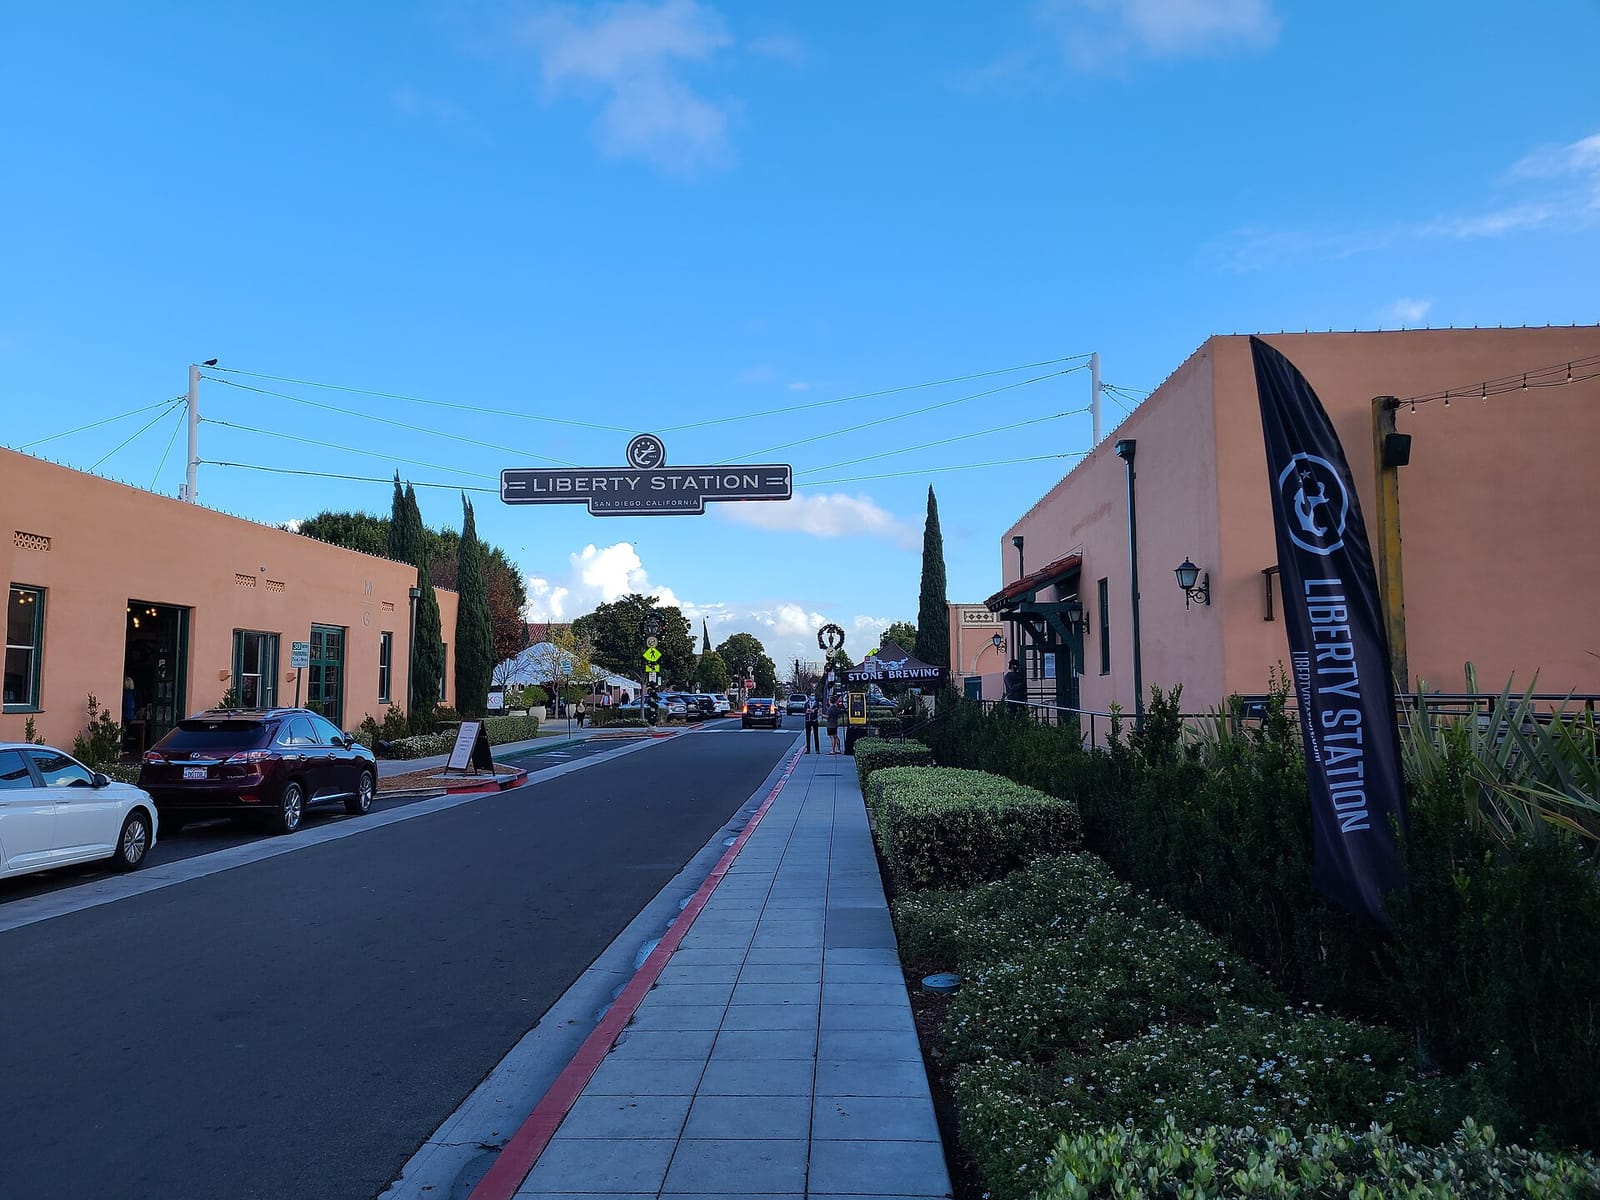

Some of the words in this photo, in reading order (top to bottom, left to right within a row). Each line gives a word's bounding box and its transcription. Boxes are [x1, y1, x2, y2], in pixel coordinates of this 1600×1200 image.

[533, 476, 641, 493] LIBERTY
[650, 474, 759, 490] STATION
[646, 499, 698, 507] CALIFORNIA
[1303, 578, 1361, 700] LIBERTY
[848, 671, 883, 681] STONE
[888, 668, 940, 679] BREWING
[1320, 708, 1371, 834] STATION
